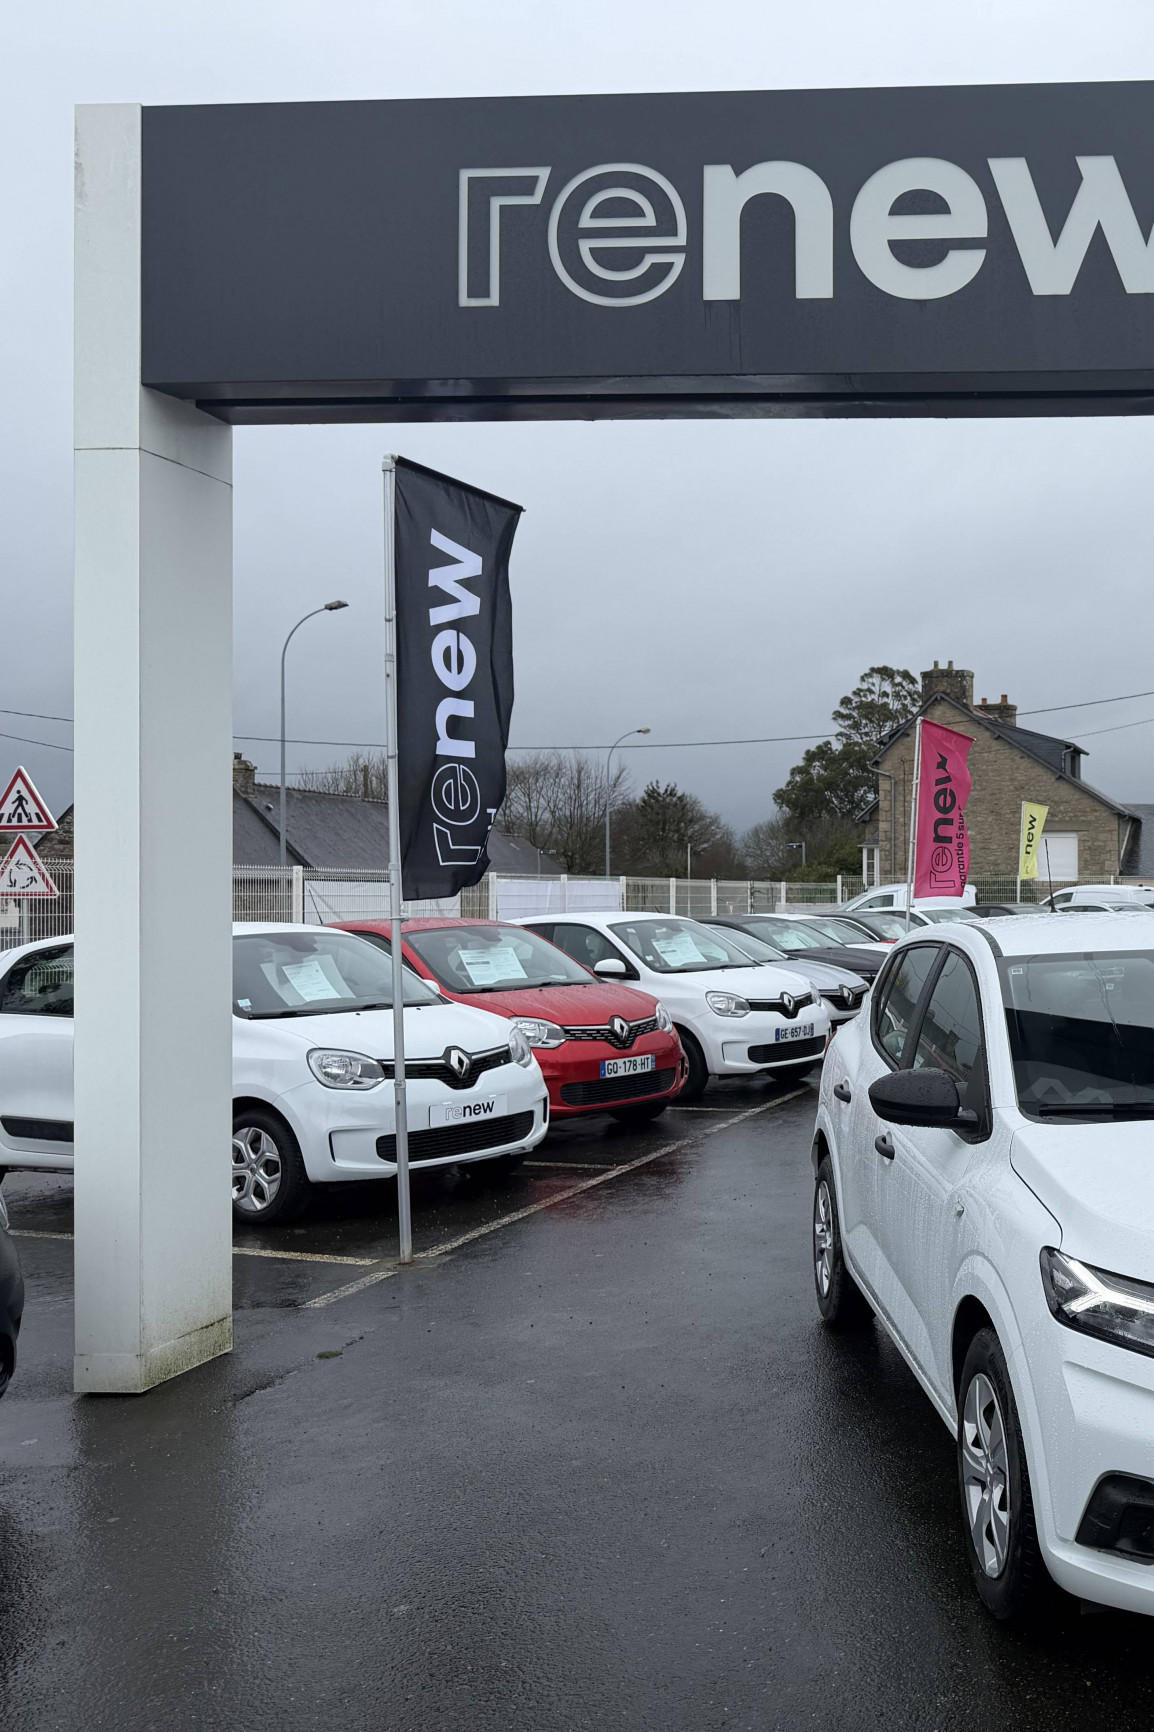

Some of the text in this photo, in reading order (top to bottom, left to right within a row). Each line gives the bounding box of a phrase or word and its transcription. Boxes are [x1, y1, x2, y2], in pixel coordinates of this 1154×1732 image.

[428, 527, 483, 867] renew
[929, 751, 957, 890] renew
[445, 1100, 495, 1121] renew
